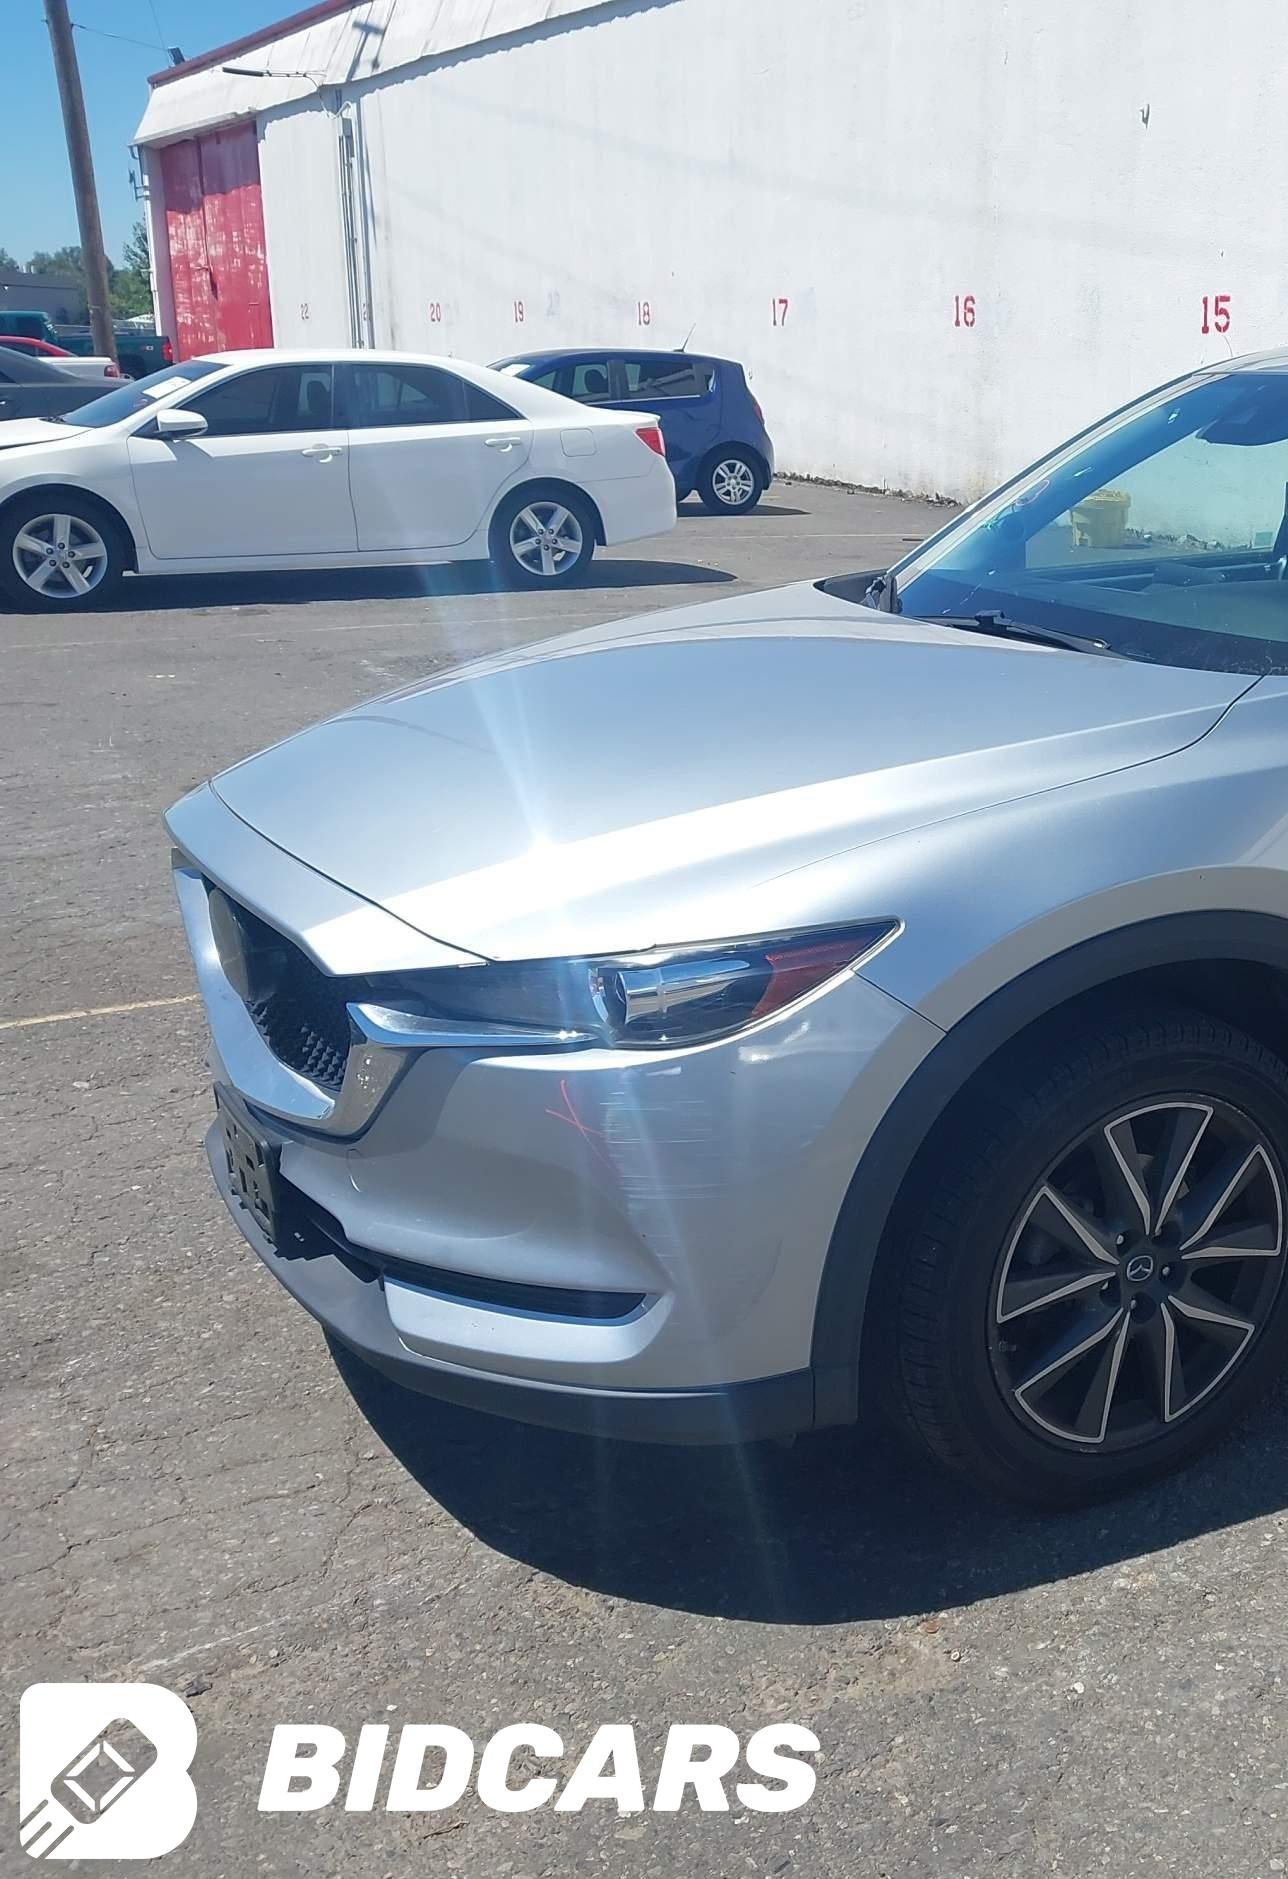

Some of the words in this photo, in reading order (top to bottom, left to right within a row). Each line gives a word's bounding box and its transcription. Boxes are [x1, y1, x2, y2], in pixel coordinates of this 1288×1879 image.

[429, 303, 442, 322] 20
[513, 300, 524, 323] 19
[637, 301, 651, 326] 18
[771, 298, 789, 326] 17
[953, 295, 976, 327] 16
[1201, 295, 1231, 334] 15
